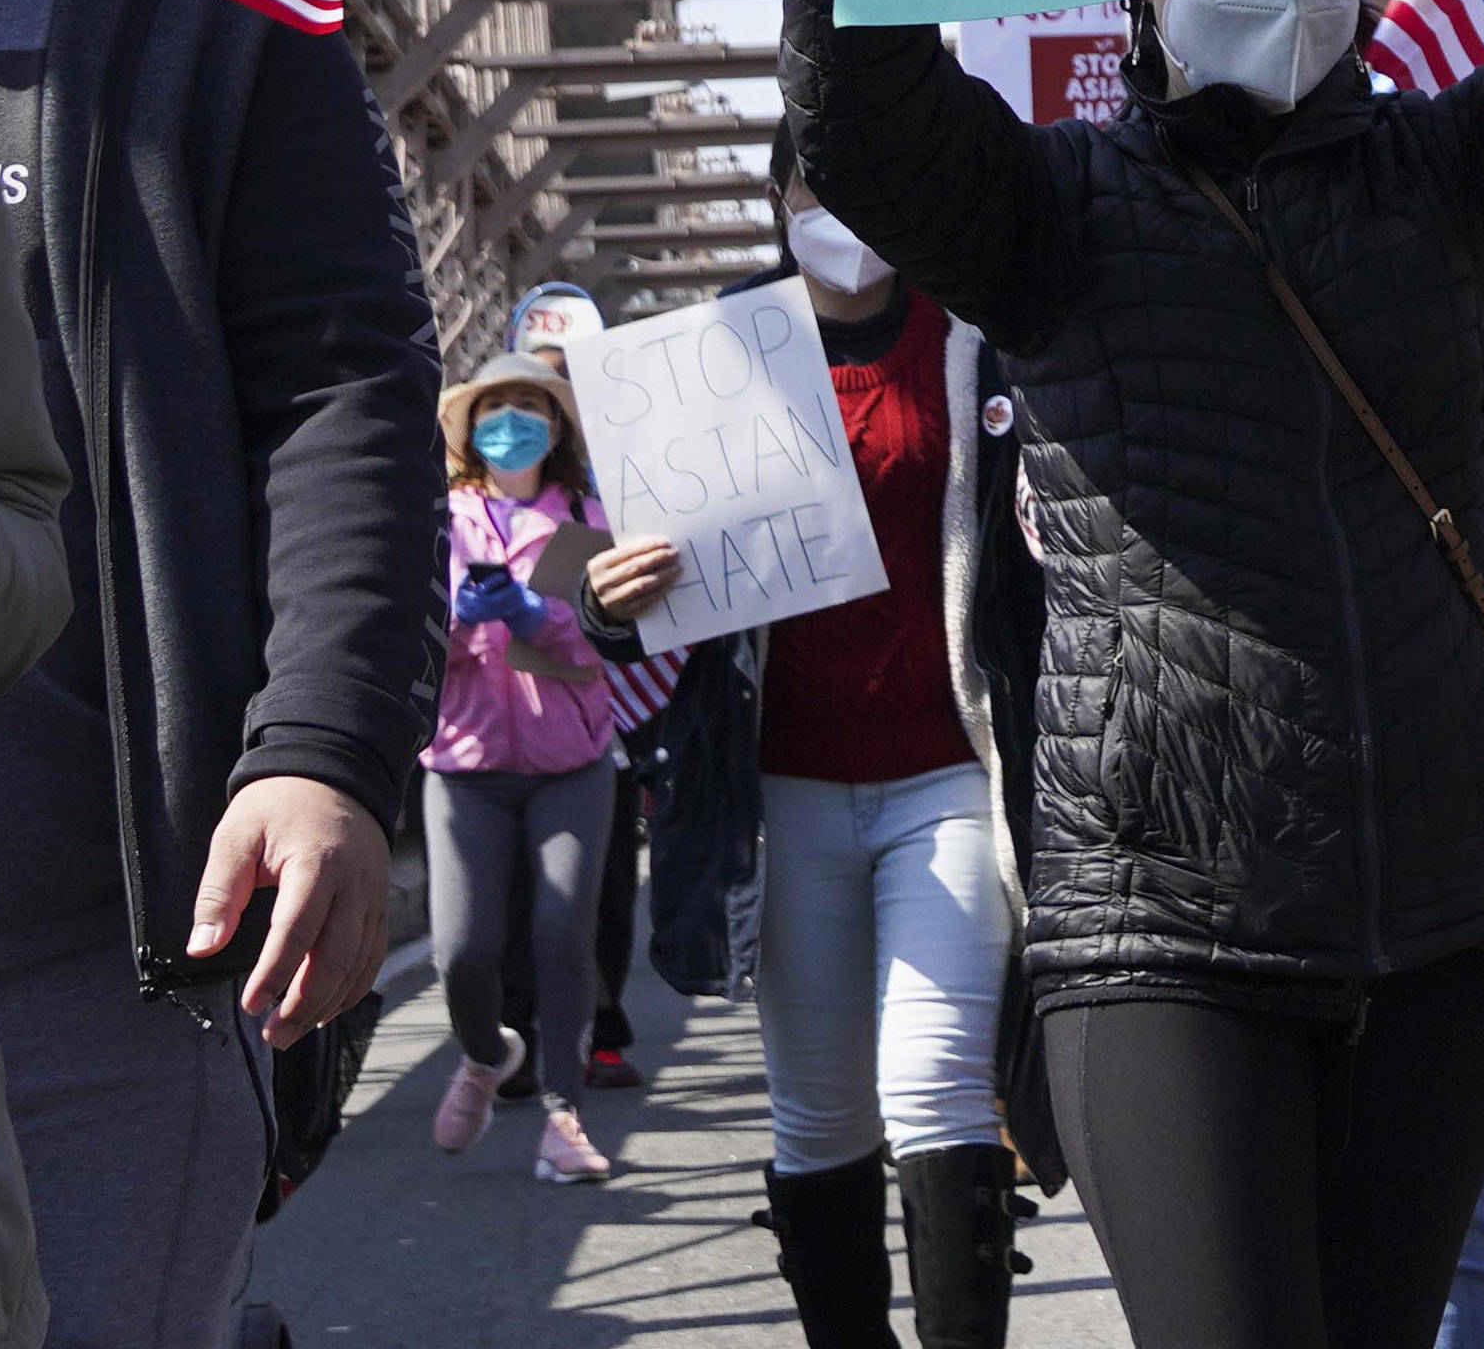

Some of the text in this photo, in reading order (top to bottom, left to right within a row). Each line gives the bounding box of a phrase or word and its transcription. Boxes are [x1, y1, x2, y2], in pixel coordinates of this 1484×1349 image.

[1064, 77, 1129, 101] ASIA
[1071, 52, 1122, 78] STO
[1073, 101, 1123, 125] HAT
[603, 305, 794, 428] STOP
[619, 392, 841, 532] ASIAN
[664, 502, 850, 628] HATE
